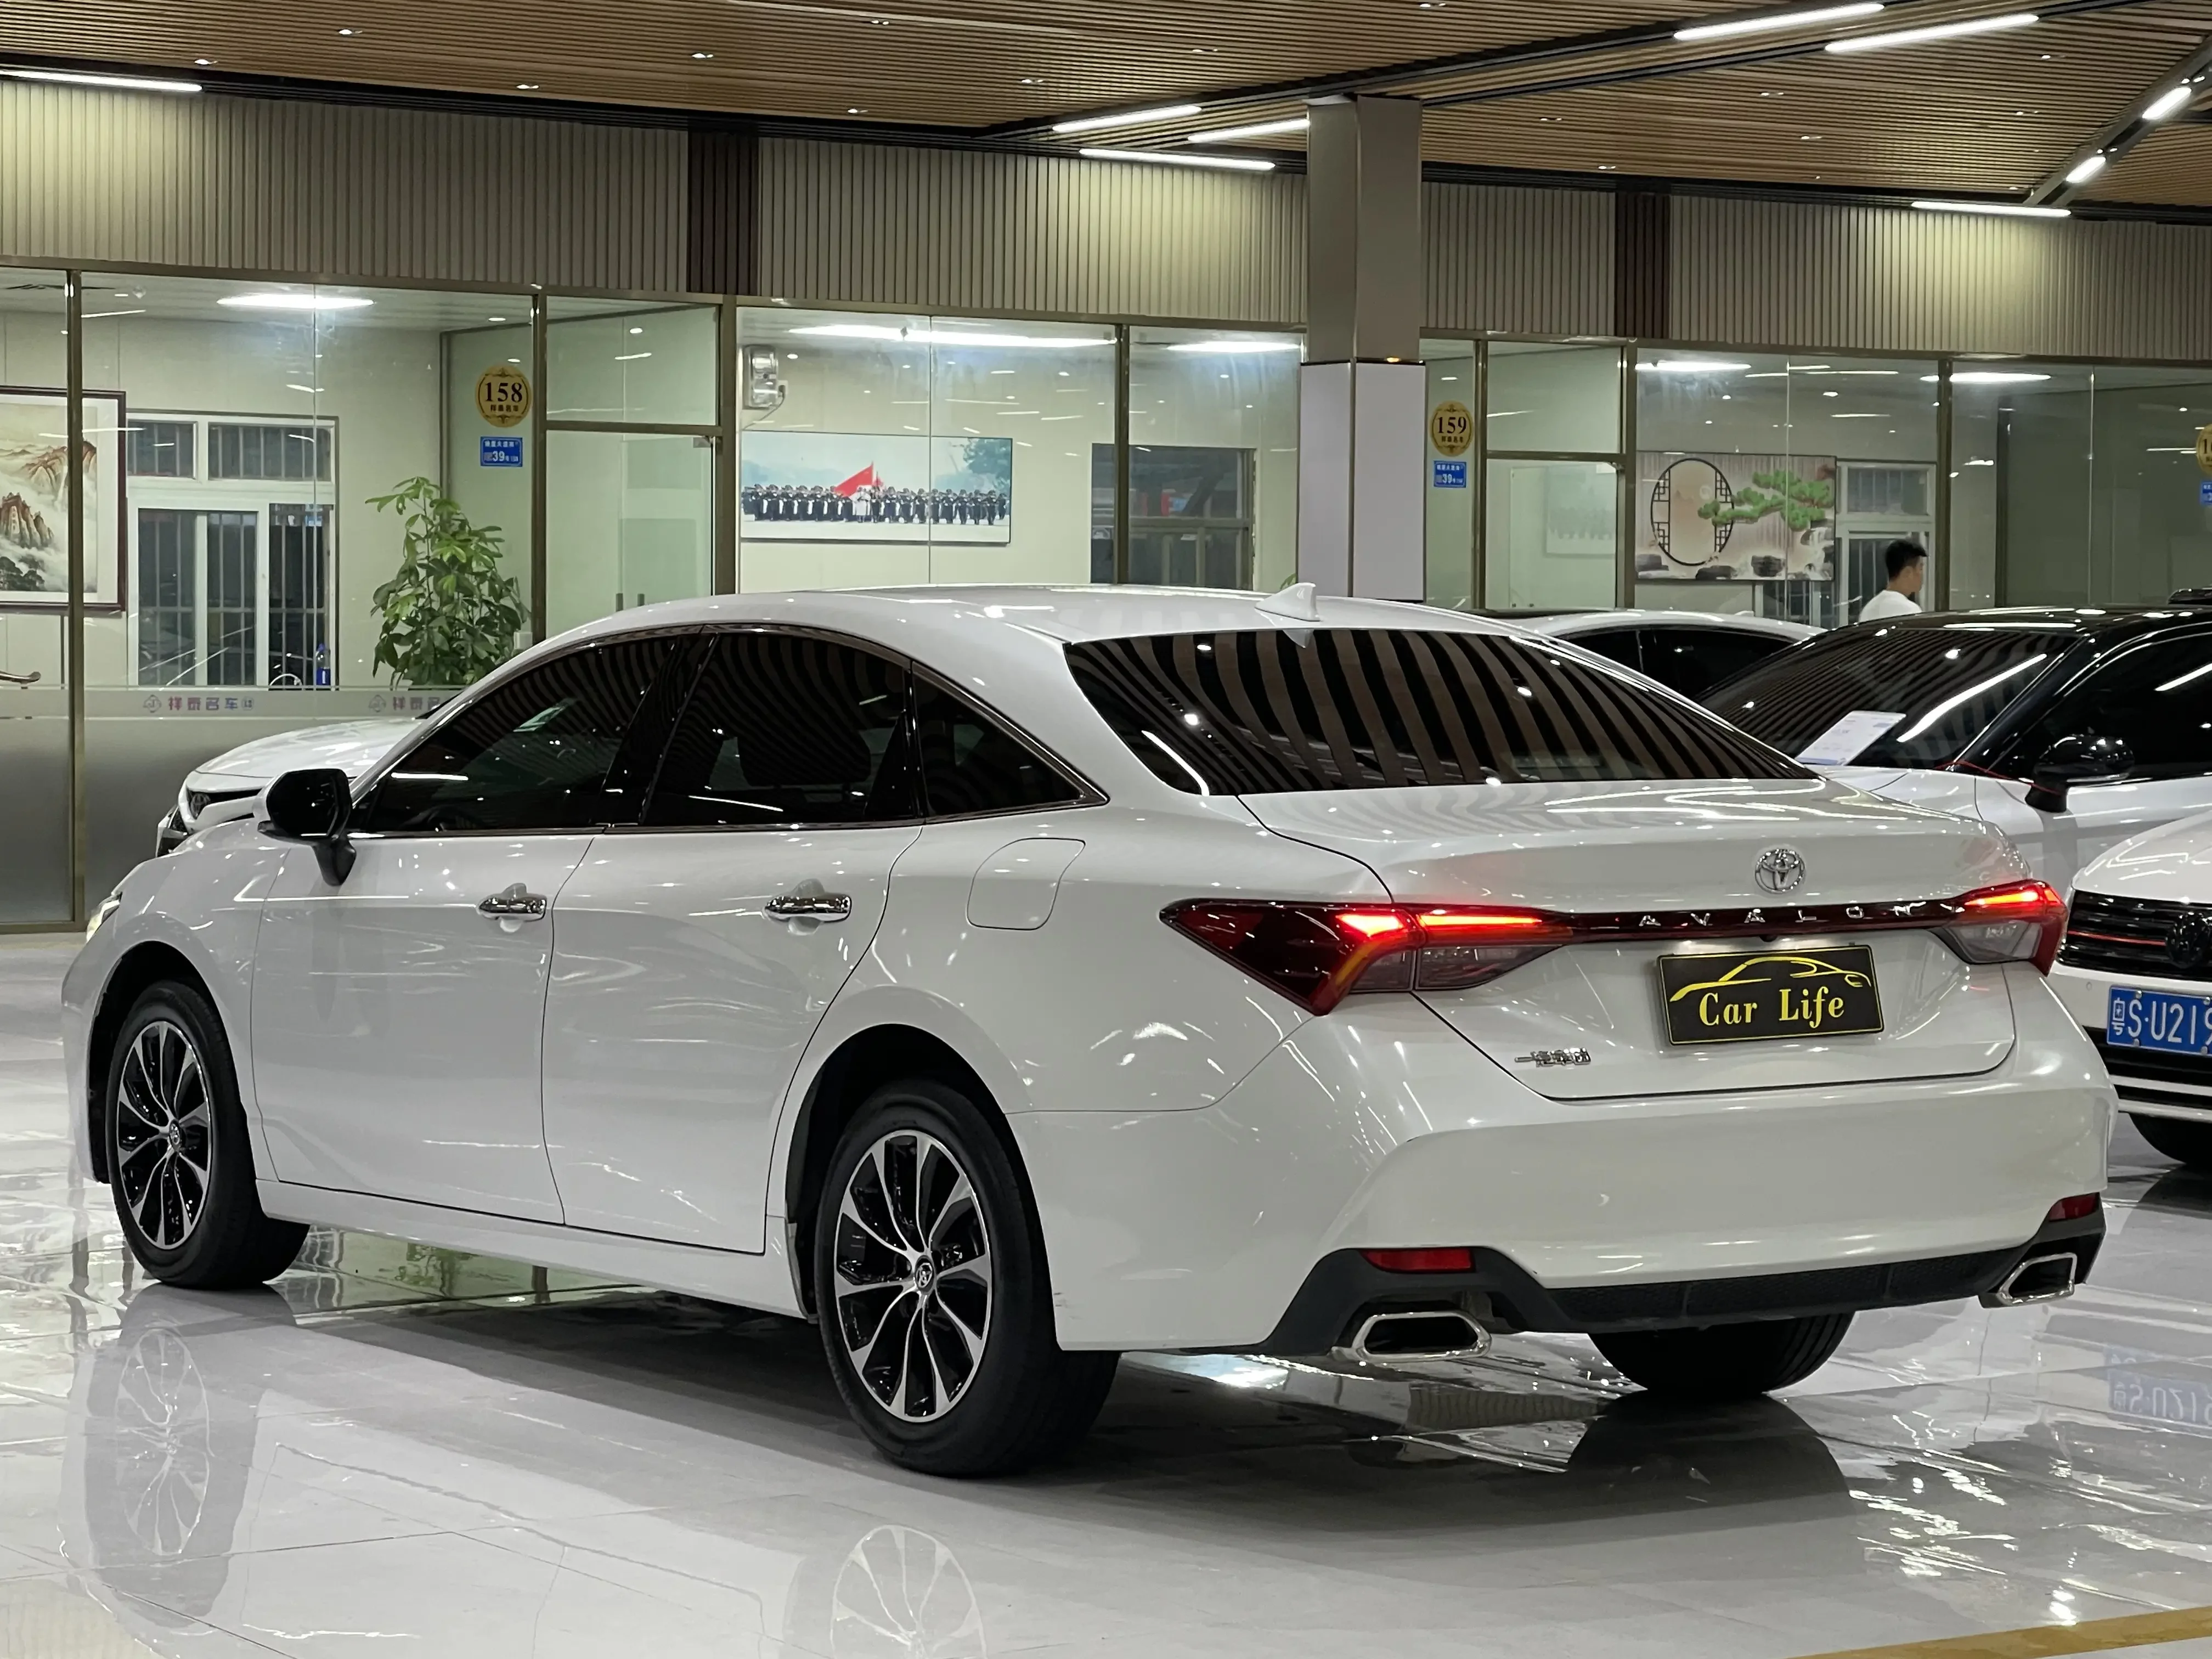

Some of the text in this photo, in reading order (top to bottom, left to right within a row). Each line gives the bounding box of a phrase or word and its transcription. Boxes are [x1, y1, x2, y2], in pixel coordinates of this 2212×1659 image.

[485, 382, 522, 403] 158
[1437, 416, 1466, 434] 159
[1639, 904, 1912, 927] AVALON
[1700, 986, 1844, 1028] Car Life
